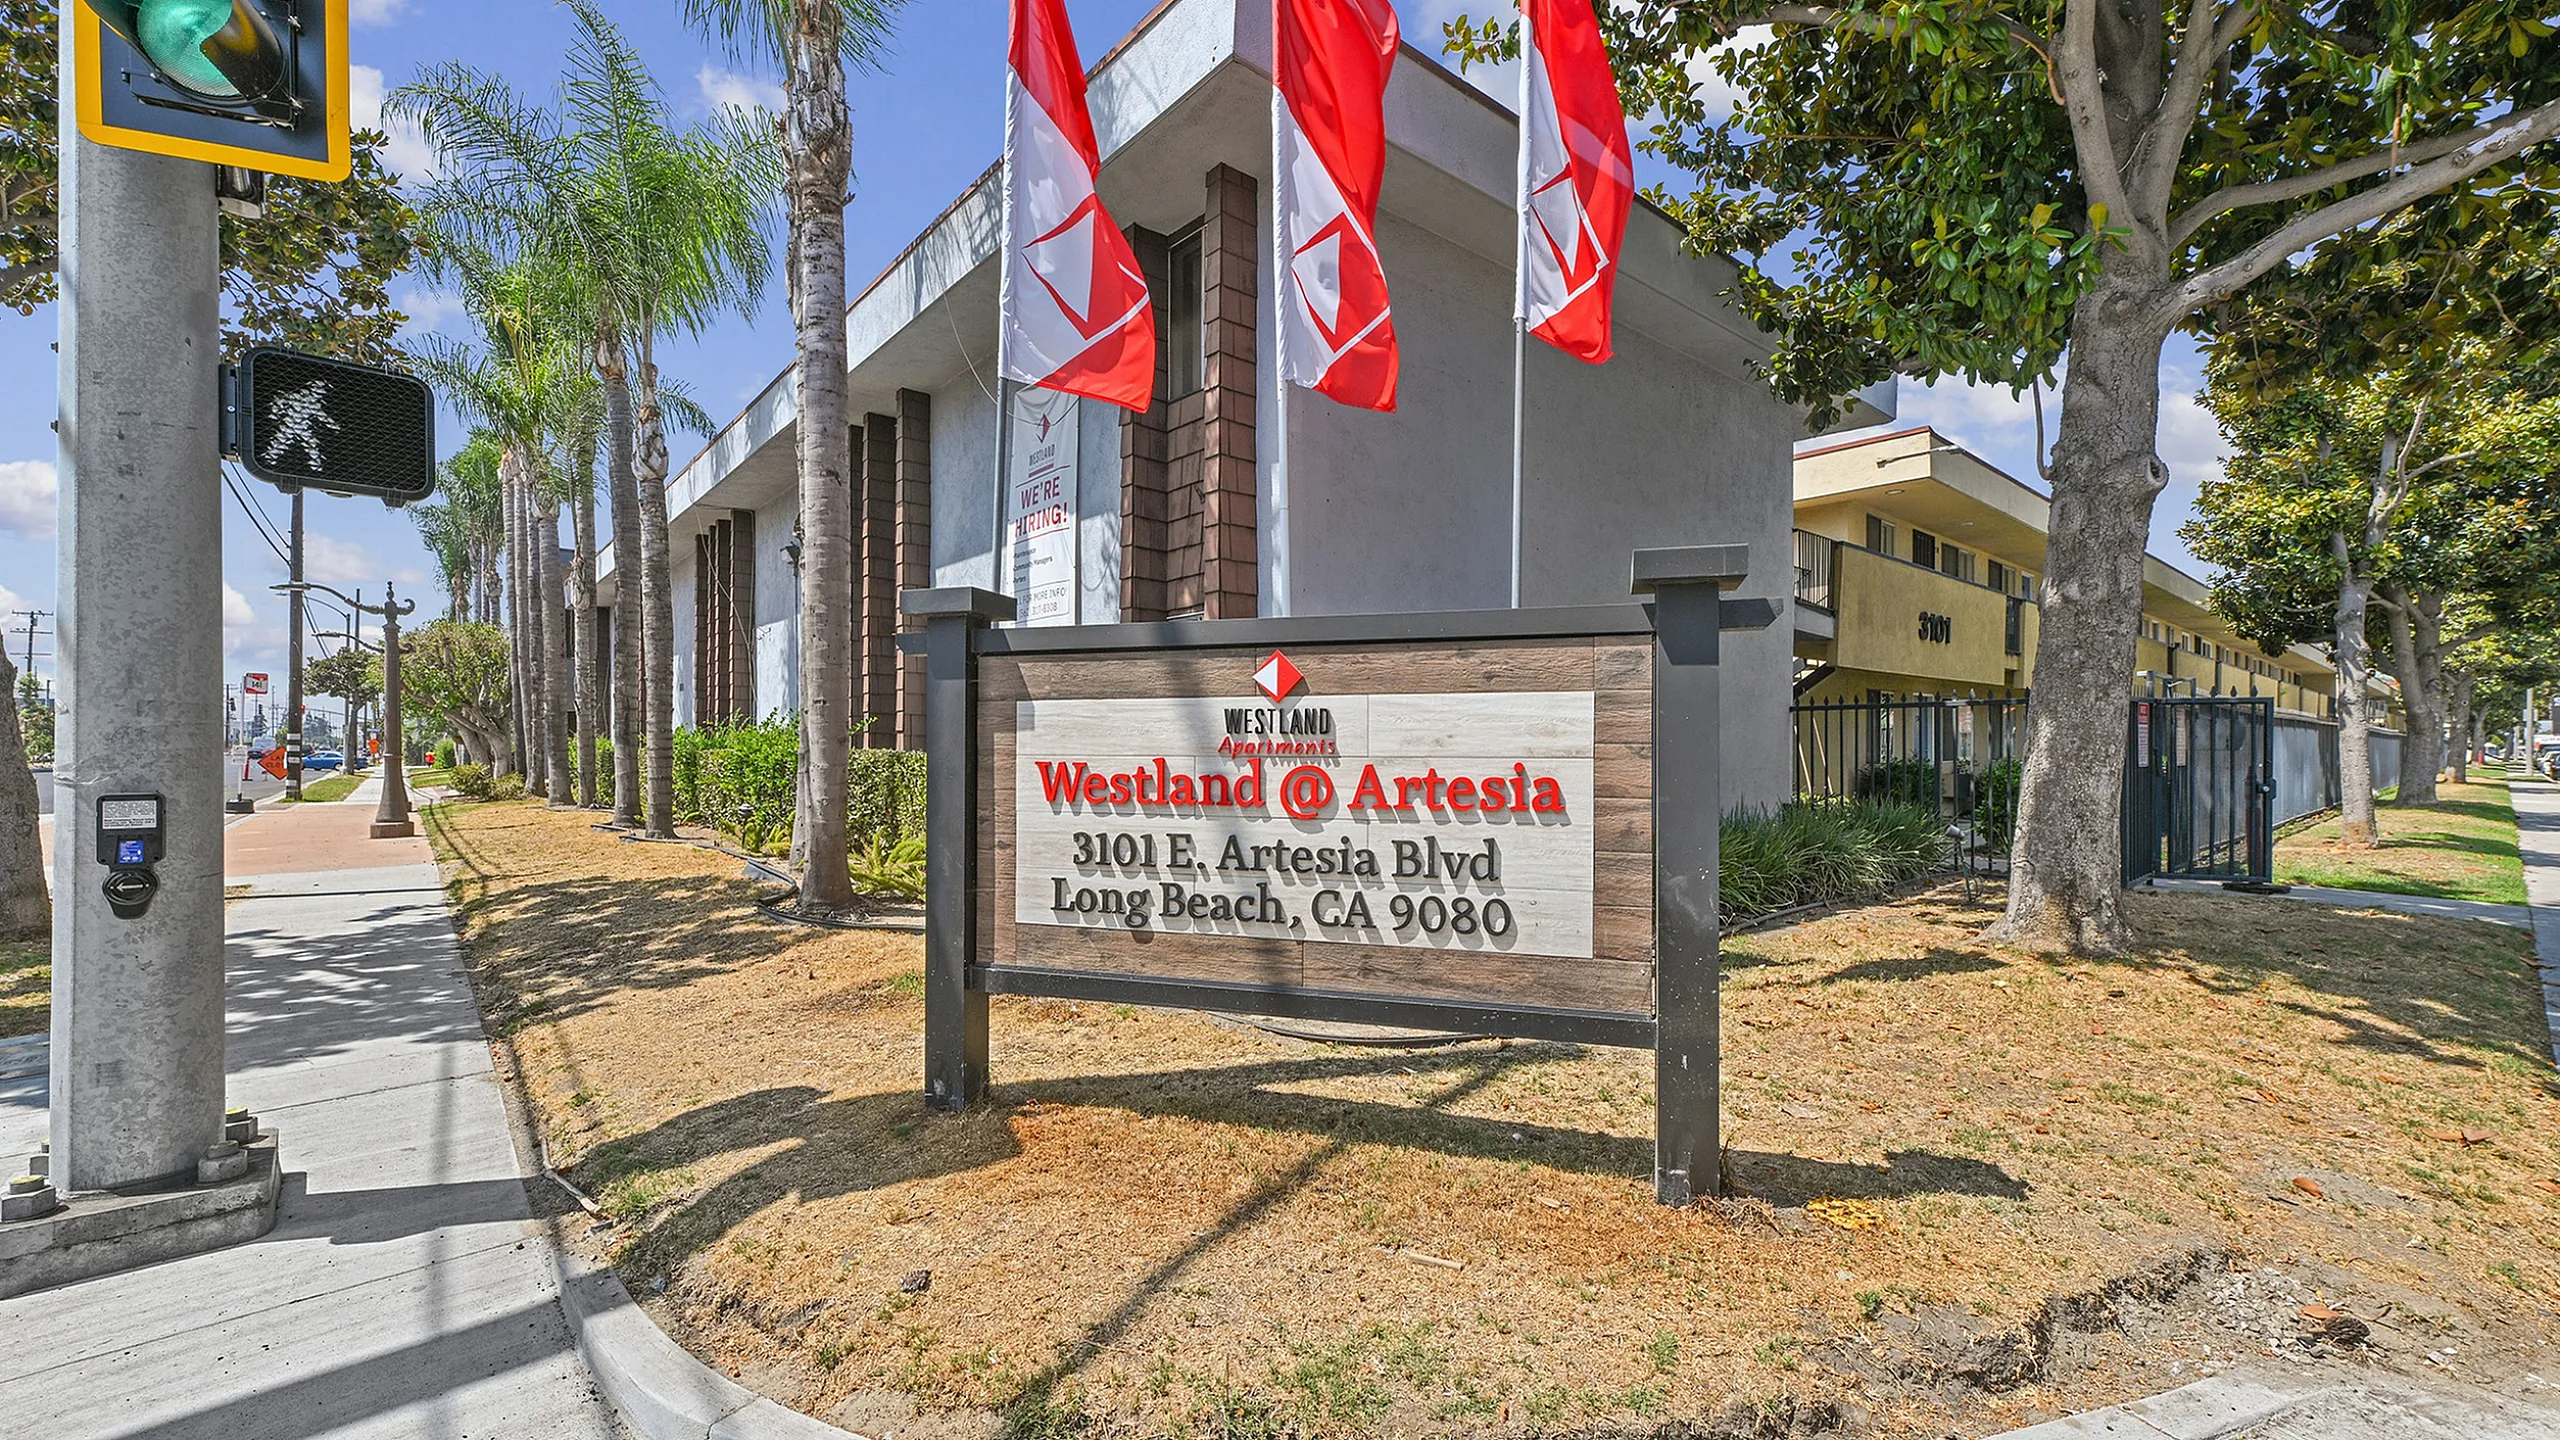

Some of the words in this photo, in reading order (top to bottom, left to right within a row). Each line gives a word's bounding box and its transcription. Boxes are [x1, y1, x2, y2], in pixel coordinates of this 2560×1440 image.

[1029, 444, 1055, 467] WESTLAND
[1021, 476, 1061, 510] WE'RE
[1015, 502, 1067, 538] HIRING!
[1918, 611, 1951, 644] 3101
[1224, 708, 1331, 735] WESTLAND
[1217, 736, 1336, 759] Apartments
[1035, 757, 1265, 808] Westland
[1279, 764, 1334, 820] @
[1347, 762, 1566, 814] Artesia
[1073, 832, 1157, 868] 3101
[1166, 833, 1206, 870] E.
[1215, 834, 1380, 876] Artesia
[1391, 835, 1499, 882] Blvd
[1050, 877, 1150, 928] Long
[1159, 882, 1301, 930] Beach,
[1311, 889, 1377, 929] CA
[1389, 894, 1512, 937] 9080
